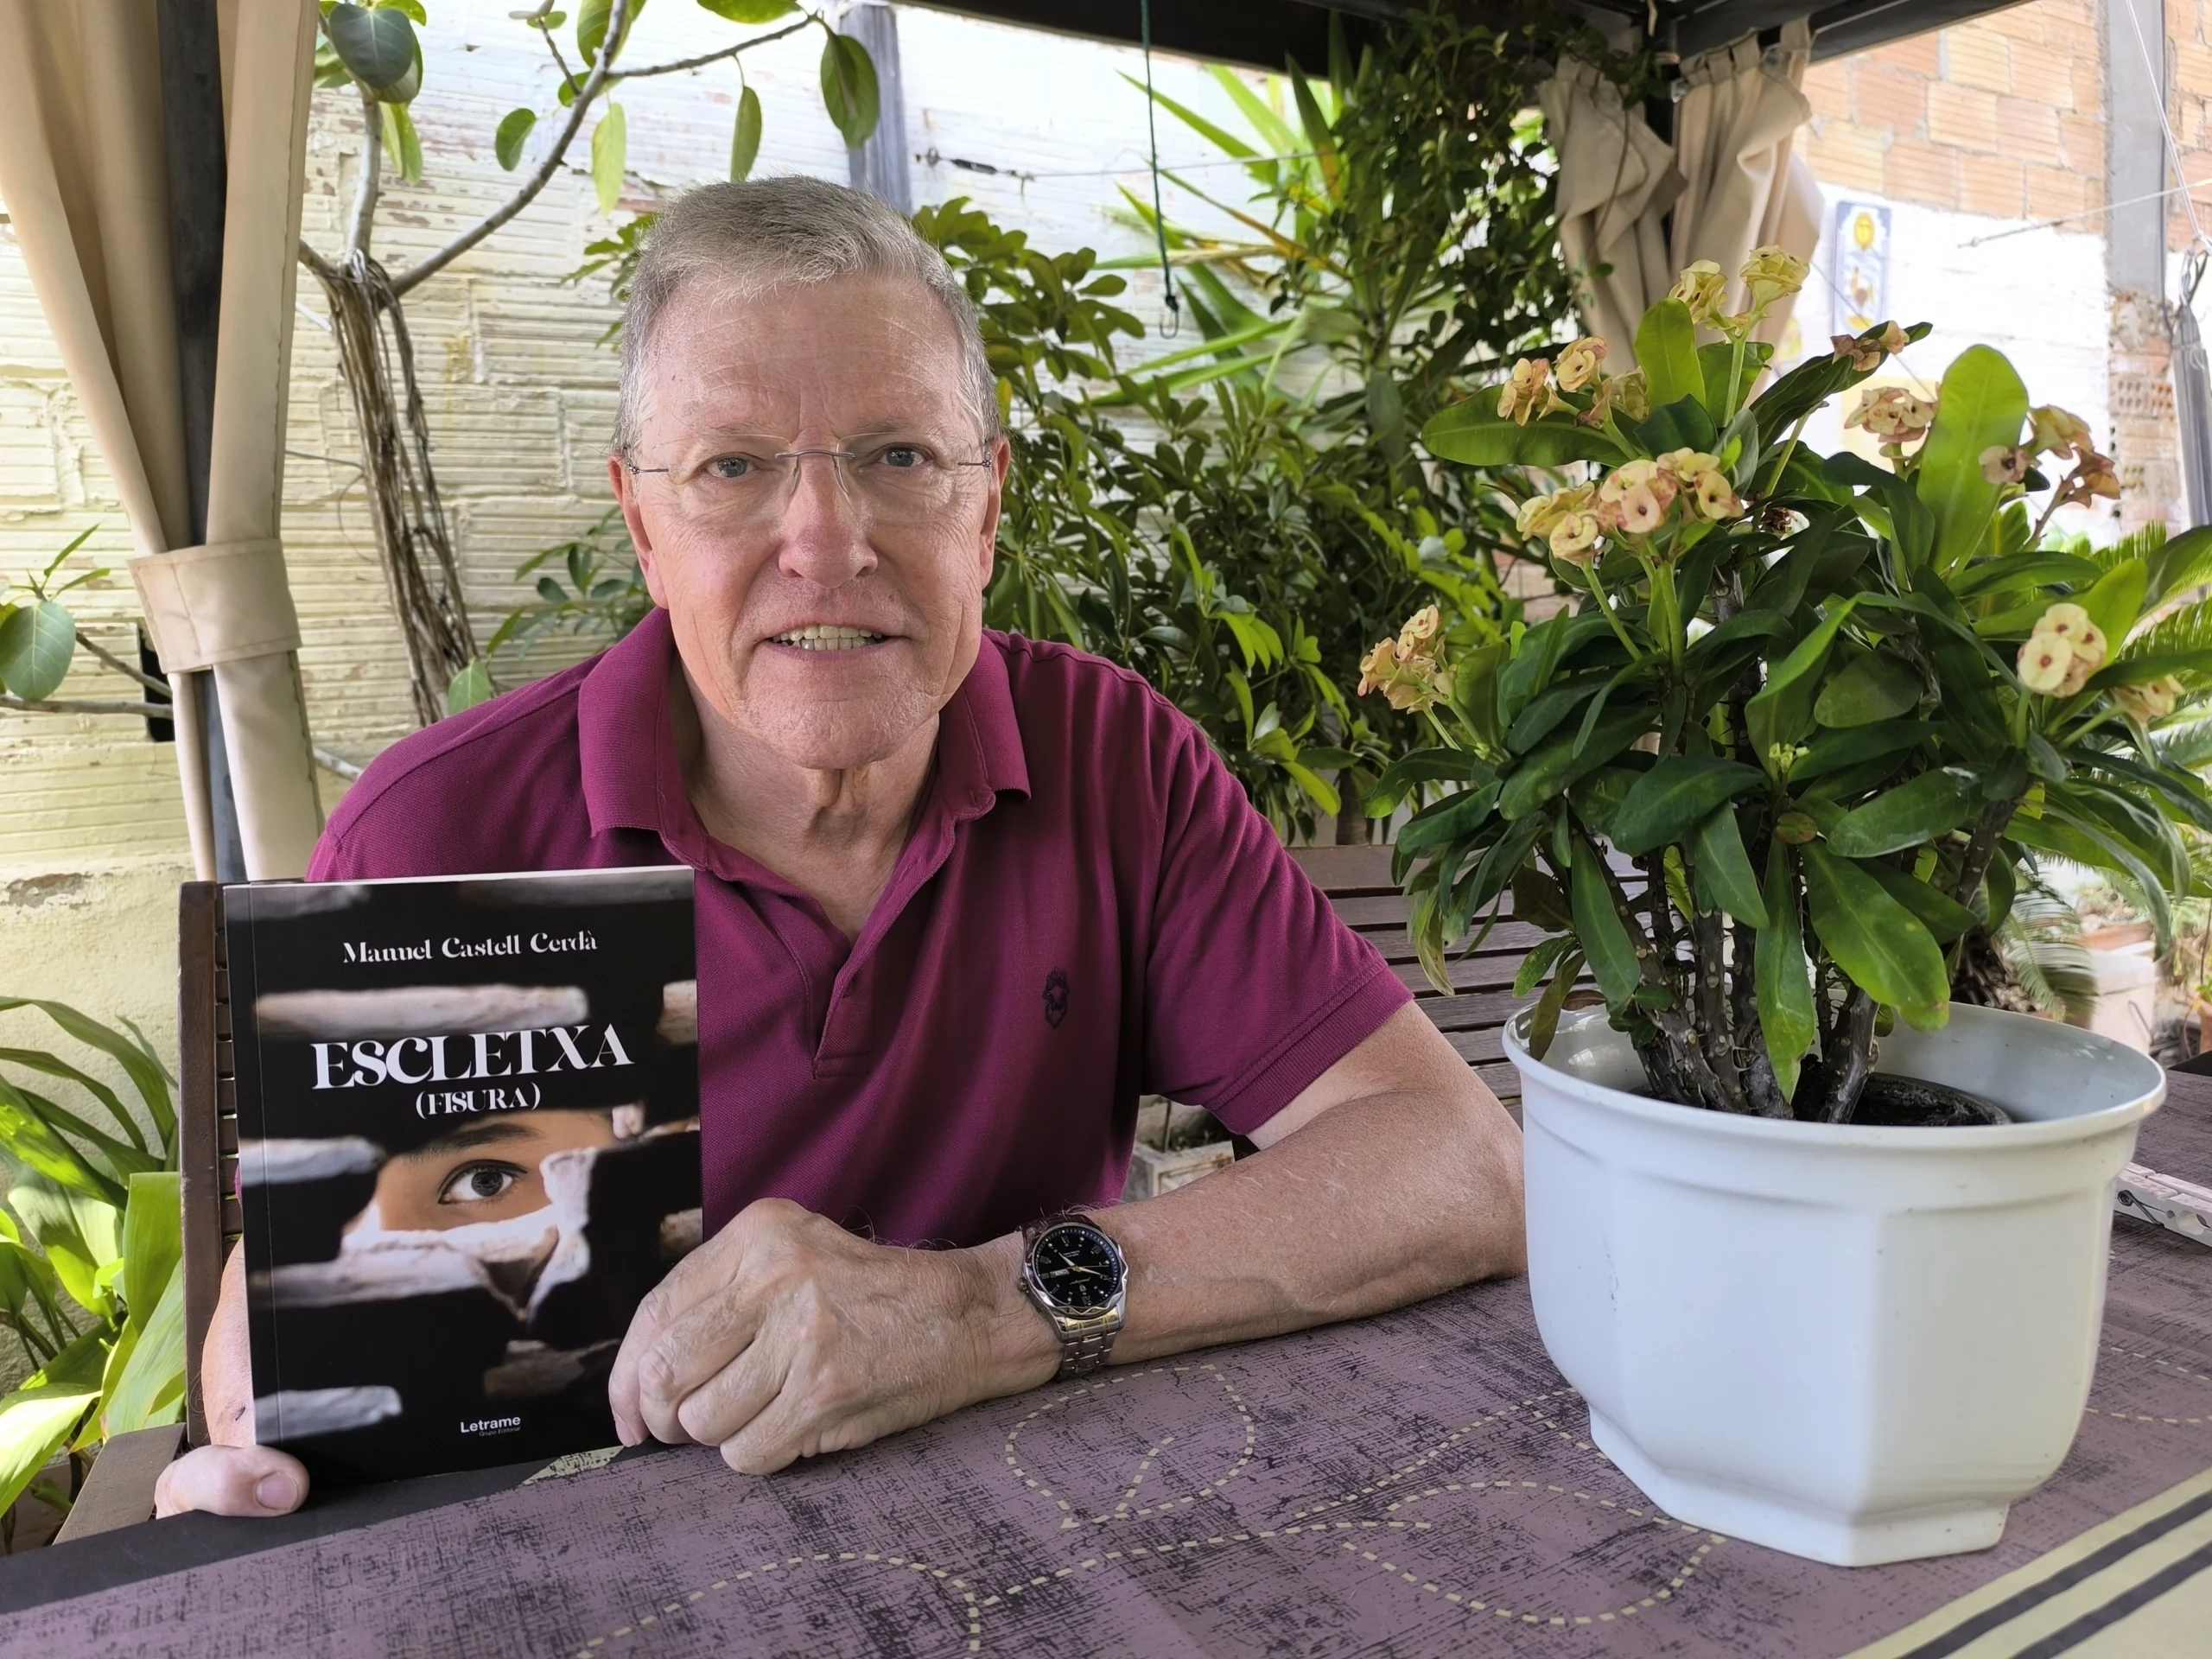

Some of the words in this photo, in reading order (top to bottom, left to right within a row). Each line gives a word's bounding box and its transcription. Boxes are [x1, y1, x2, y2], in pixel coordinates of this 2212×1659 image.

[343, 939, 433, 963] Manuel
[442, 934, 521, 958] Castell
[530, 930, 598, 953] Cerdà
[309, 1023, 635, 1090] ESCLETXA
[416, 1082, 541, 1119] (FISURA)
[461, 1416, 521, 1433] Letrame
